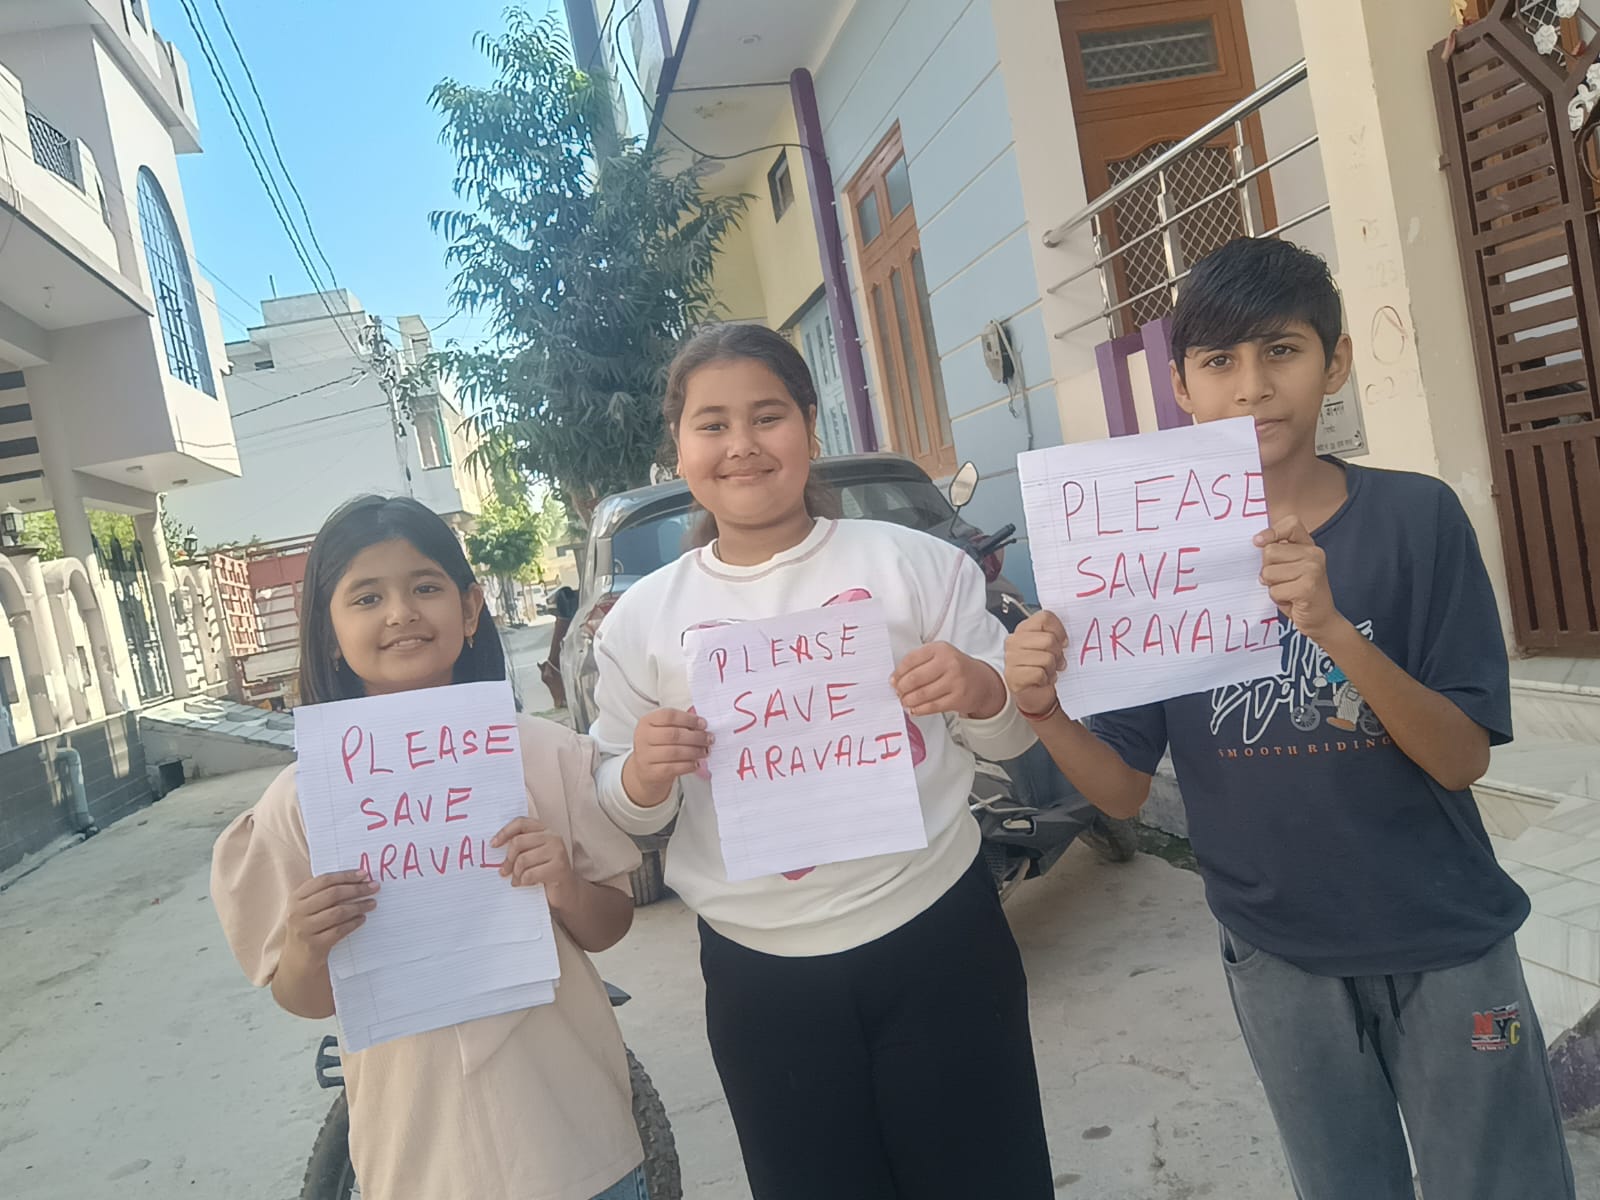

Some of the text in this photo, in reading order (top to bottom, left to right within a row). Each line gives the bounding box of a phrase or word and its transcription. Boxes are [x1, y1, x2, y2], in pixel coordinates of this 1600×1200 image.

[1062, 469, 1268, 541] PLEASE
[1076, 547, 1200, 600] SAVE
[709, 623, 858, 683] PLEASE
[1080, 608, 1281, 666] ARAVALLI
[733, 682, 859, 734] SAVE
[341, 725, 516, 784] PLEASE
[737, 732, 902, 780] ARAVALI
[1307, 737, 1391, 753] RIDING
[360, 787, 472, 831] SAVE
[1472, 1011, 1520, 1045] NYC
